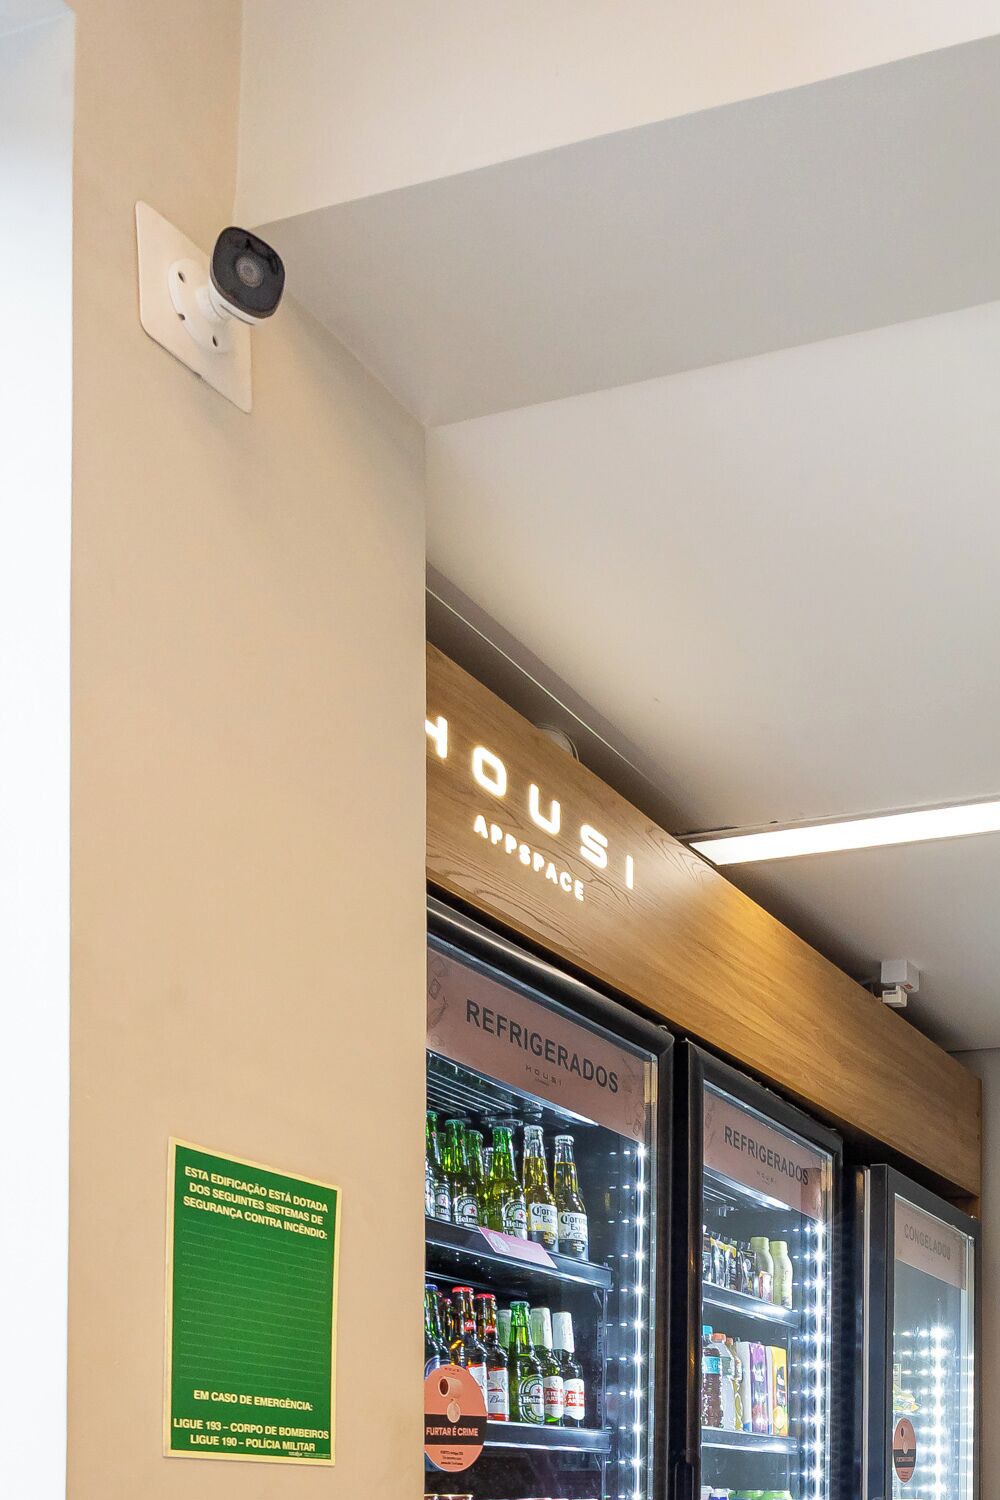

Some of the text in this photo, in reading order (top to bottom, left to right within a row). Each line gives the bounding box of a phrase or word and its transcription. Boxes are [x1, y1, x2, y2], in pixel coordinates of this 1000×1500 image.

[473, 814, 585, 902] APPSPACE
[466, 998, 619, 1094] REFRIGERADOS
[724, 1125, 809, 1186] REFRIGERADOS
[184, 1165, 329, 1214] ESTA EDIFICAÇÃO ESTÁ DOTADA
[189, 1182, 324, 1225] DOS SEGUINTES SISTEMAS DE
[183, 1196, 328, 1240] SEGURANÇA CONTRA INCÊNDIO:
[193, 1389, 313, 1411] EM CASO DE EMERGÊNCIA:
[173, 1417, 203, 1430] LIGUE
[205, 1420, 222, 1431] 193
[230, 1422, 264, 1434] CORPO
[264, 1425, 278, 1436] DE
[278, 1426, 329, 1440] BOMBEIROS
[190, 1434, 220, 1446] LIGUE
[222, 1437, 238, 1447] 190
[245, 1437, 281, 1449] POLÍCIA
[282, 1440, 316, 1452] MILITAR
[425, 1425, 479, 1437] FURTAR É CRIME
